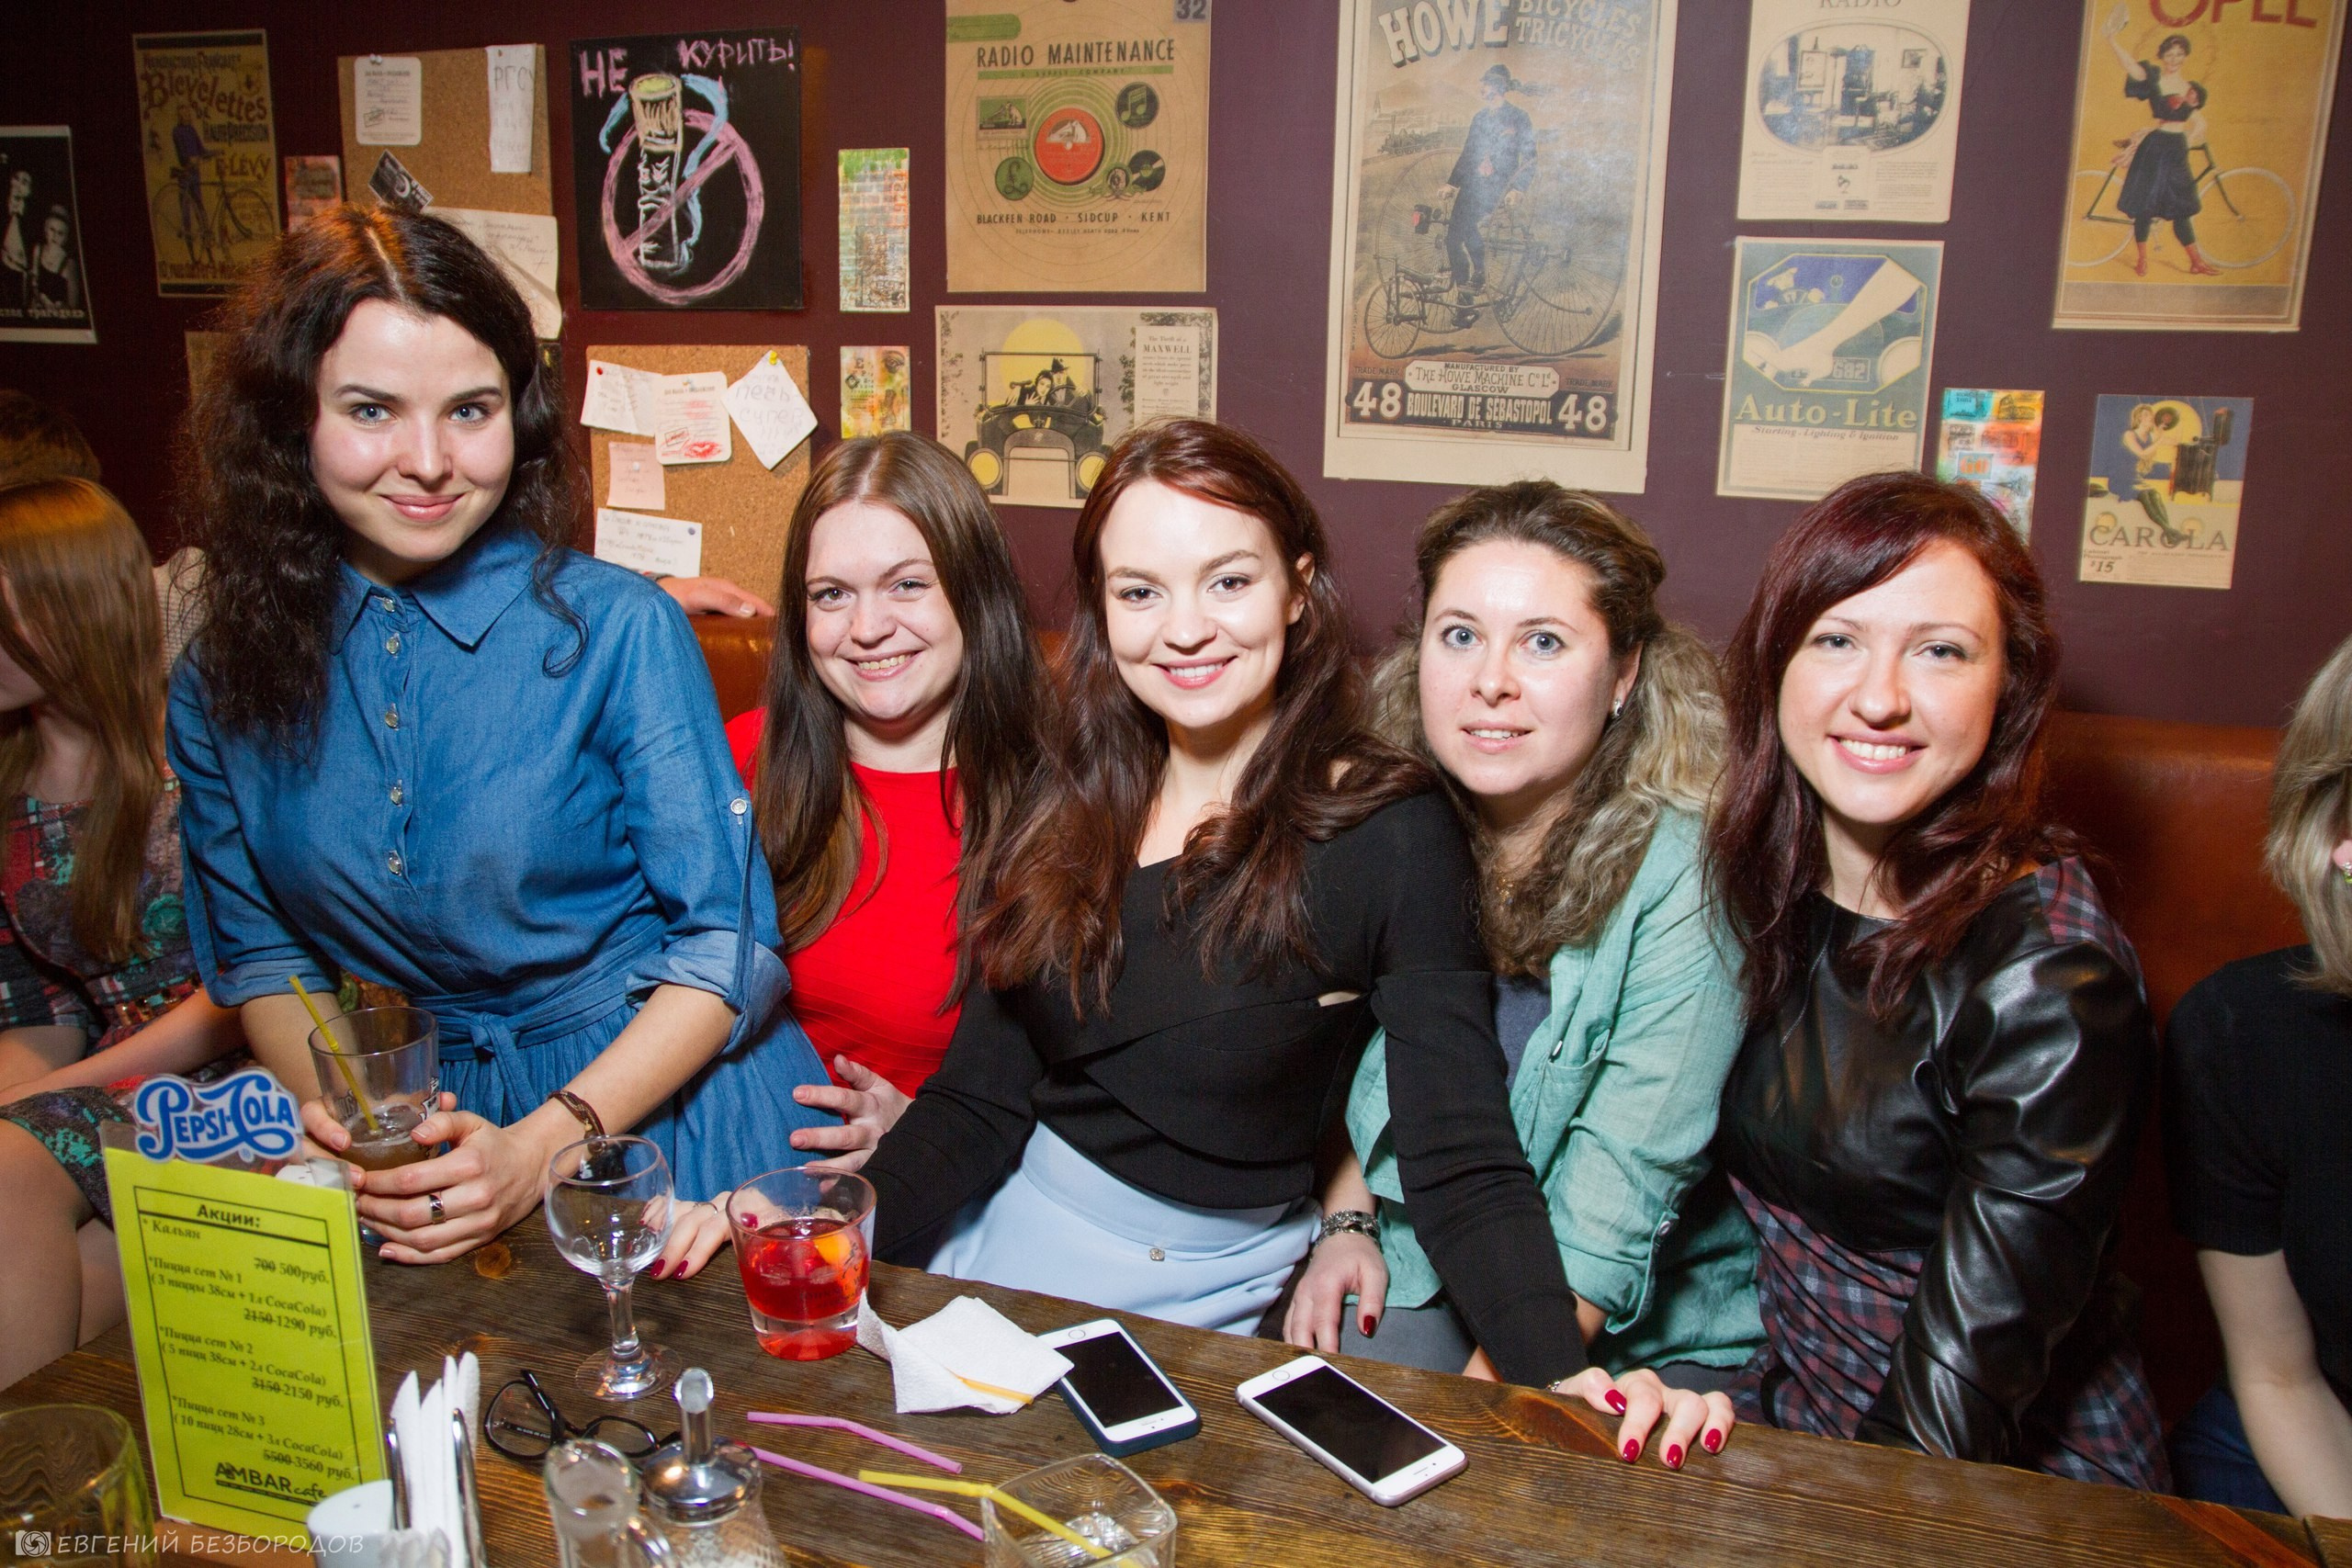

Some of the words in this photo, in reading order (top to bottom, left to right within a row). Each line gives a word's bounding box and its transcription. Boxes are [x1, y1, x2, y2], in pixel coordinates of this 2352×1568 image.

[1175, 0, 1206, 20] 32
[1518, 0, 1643, 39] BICYCLES
[1378, 0, 1510, 67] HOWE
[1517, 17, 1641, 71] TRICYCLES
[977, 45, 1035, 68] RADIO
[1047, 39, 1175, 65] MAINTENANCE
[579, 48, 628, 98] НЕ
[676, 38, 796, 72] КУРИТЬ!
[1035, 69, 1068, 77] SUPPLY
[1080, 68, 1125, 76] COMPANY
[977, 213, 1023, 225] BLACKFEN
[1029, 212, 1057, 223] ROAD
[1078, 211, 1118, 223] SIDCUP
[1141, 211, 1171, 222] KENT
[1143, 344, 1193, 354] MAXWELL
[1353, 367, 1376, 376] TRADE
[1379, 367, 1400, 376] MARK
[1416, 367, 1435, 382] THE
[1438, 369, 1471, 384] HOWE
[1474, 369, 1524, 387] MACHINE
[1444, 362, 1506, 373] MANUFACTURED
[1566, 378, 1589, 387] TRADE
[1591, 378, 1614, 389] MARK
[1353, 381, 1402, 418] 48
[1407, 392, 1464, 419] BOULEVARD
[1468, 396, 1481, 420] DE
[1486, 396, 1553, 424] SÉBASTOPOL
[1735, 393, 1917, 429] Auto-Lite
[1452, 419, 1503, 429] PARIS
[1558, 393, 1607, 432] 48
[1804, 428, 1846, 441] Lighting
[1860, 432, 1899, 442] Ignition
[2089, 525, 2232, 551] CAROLA
[2090, 560, 2116, 573] $15
[196, 1204, 261, 1228] Акции:
[153, 1220, 201, 1240] Кальян
[254, 1257, 276, 1272] 700
[236, 1271, 243, 1283] 1
[208, 1283, 236, 1299] 38см
[266, 1296, 327, 1318] CocaCola)
[243, 1308, 275, 1325] 2150
[277, 1314, 305, 1331] 1290
[309, 1321, 337, 1338] руб.
[246, 1343, 254, 1354] 2
[209, 1351, 237, 1367] 38см
[266, 1364, 327, 1386] CocaCola)
[283, 1383, 313, 1401] 2150
[316, 1394, 344, 1408] руб.
[258, 1415, 266, 1426] 3
[227, 1424, 254, 1440] 28см
[282, 1437, 344, 1461] CocaCola)
[263, 1450, 293, 1466] 5500
[295, 1456, 323, 1473] 3560
[327, 1466, 354, 1481] руб.
[215, 1461, 292, 1494] AMBAR
[294, 1482, 328, 1499] cafe
